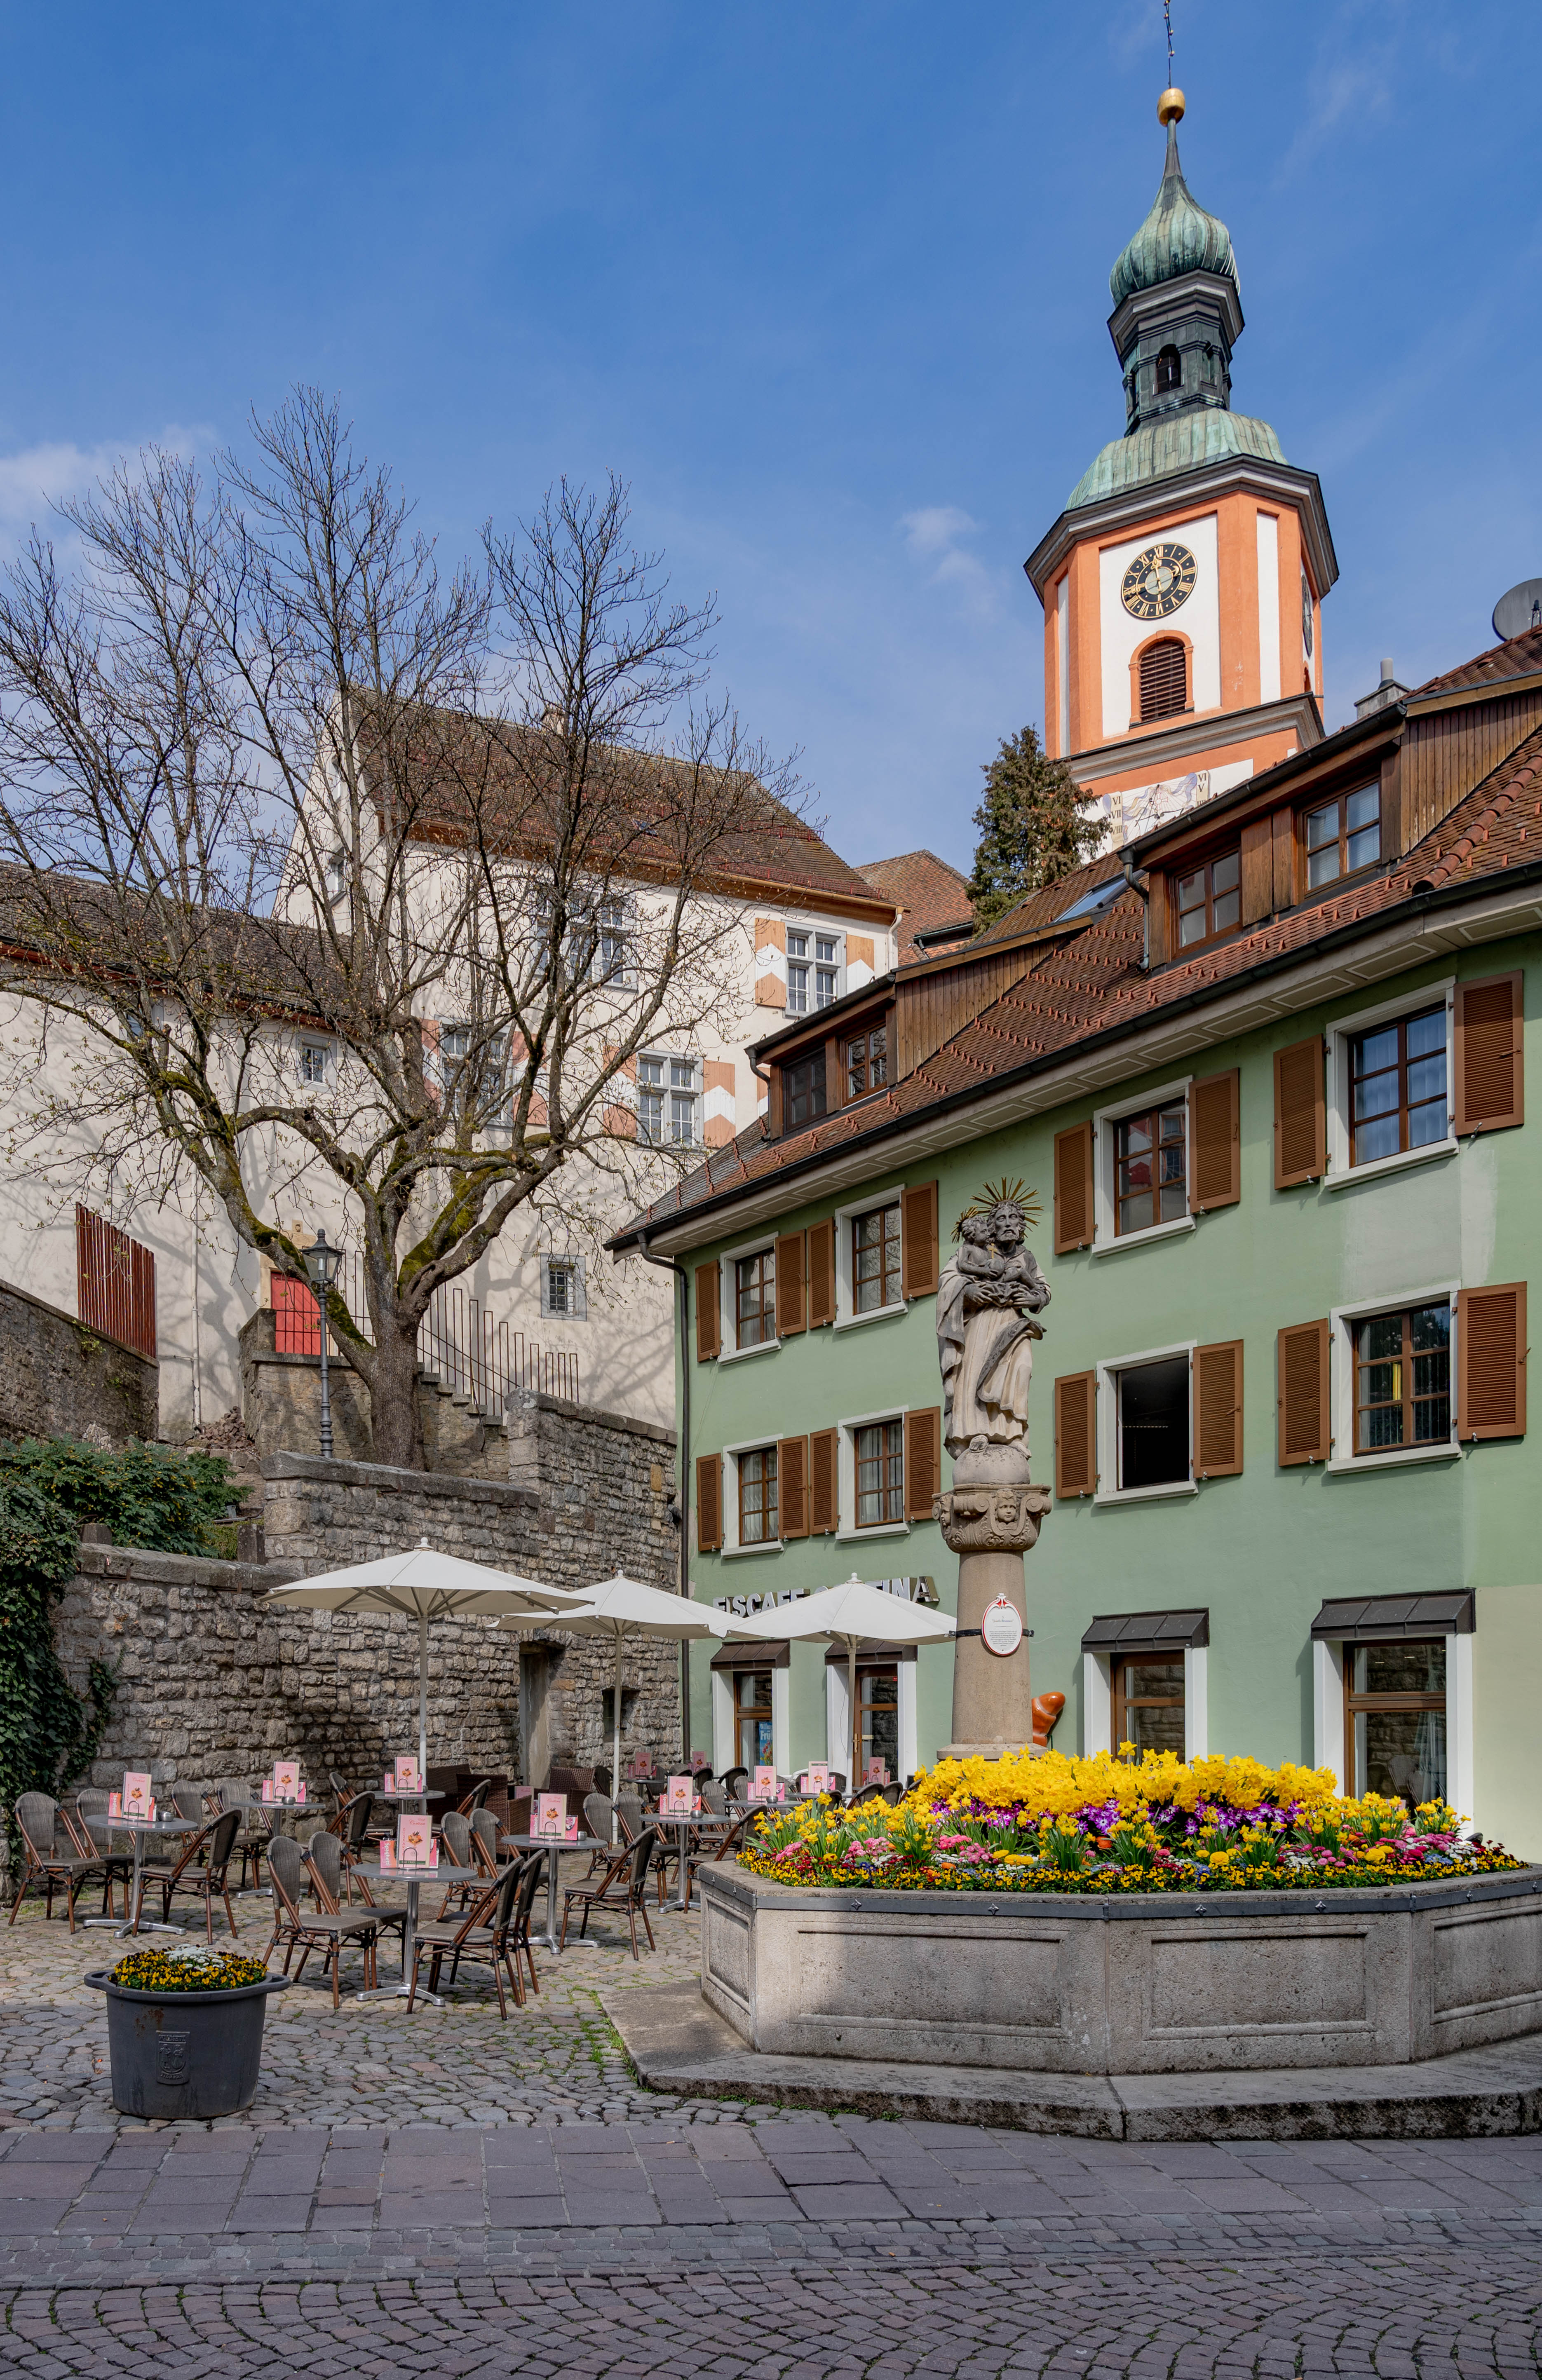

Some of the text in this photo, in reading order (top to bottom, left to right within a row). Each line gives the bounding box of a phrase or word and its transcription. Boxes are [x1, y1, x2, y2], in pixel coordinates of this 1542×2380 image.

[1138, 553, 1150, 567] XI
[1178, 552, 1191, 565] II
[1127, 570, 1140, 579] X
[1182, 566, 1195, 577] III
[1198, 773, 1206, 782] VI
[1198, 783, 1204, 792] V
[1112, 796, 1121, 805] VI
[1111, 809, 1121, 819] VII
